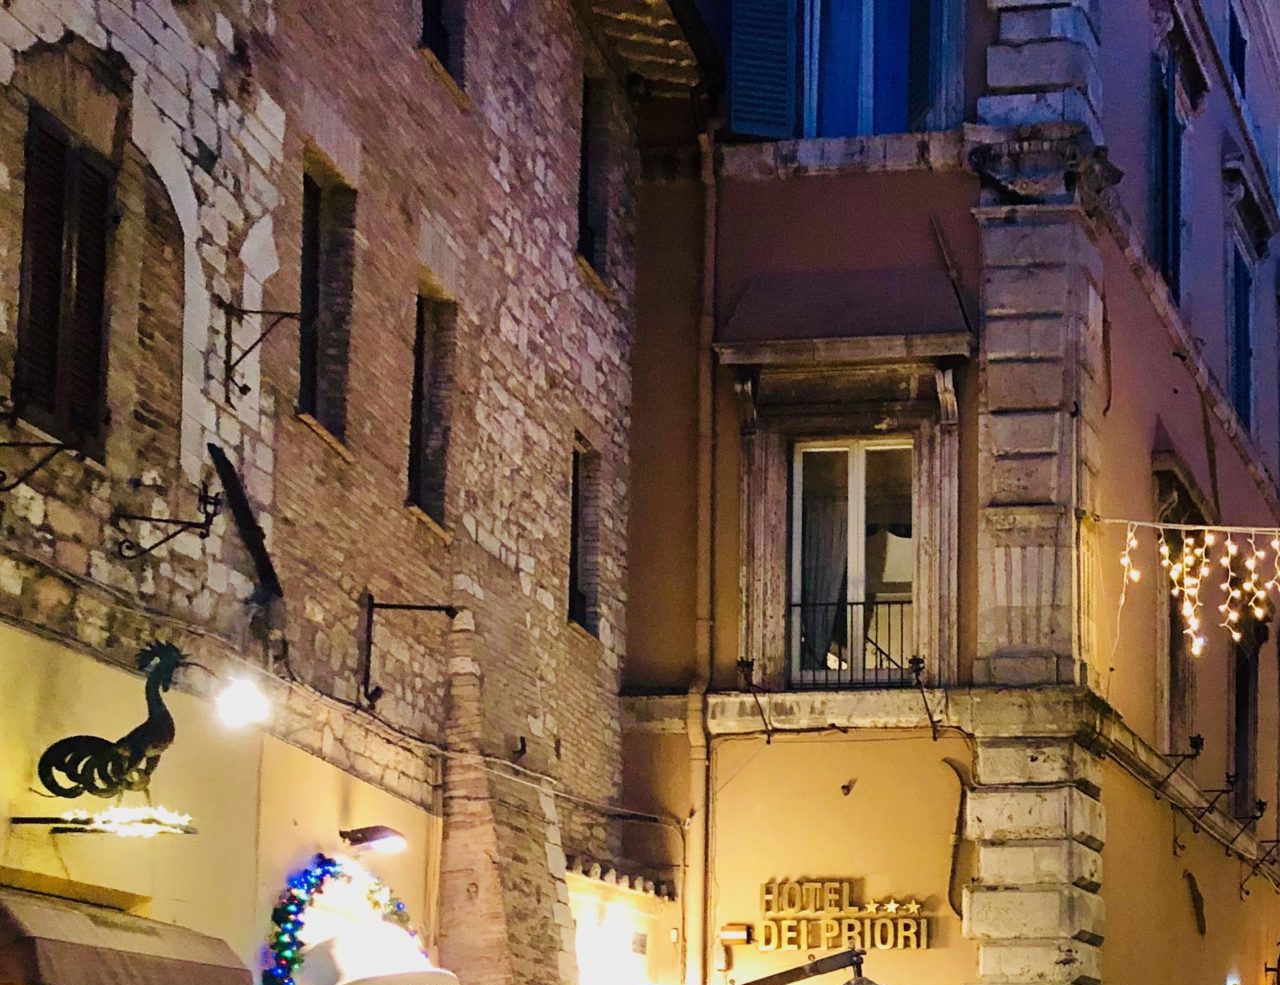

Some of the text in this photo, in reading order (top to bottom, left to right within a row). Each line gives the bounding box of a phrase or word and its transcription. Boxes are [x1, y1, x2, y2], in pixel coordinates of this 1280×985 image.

[760, 881, 860, 914] HOTEL
[758, 918, 929, 951] DEI PRIORI
